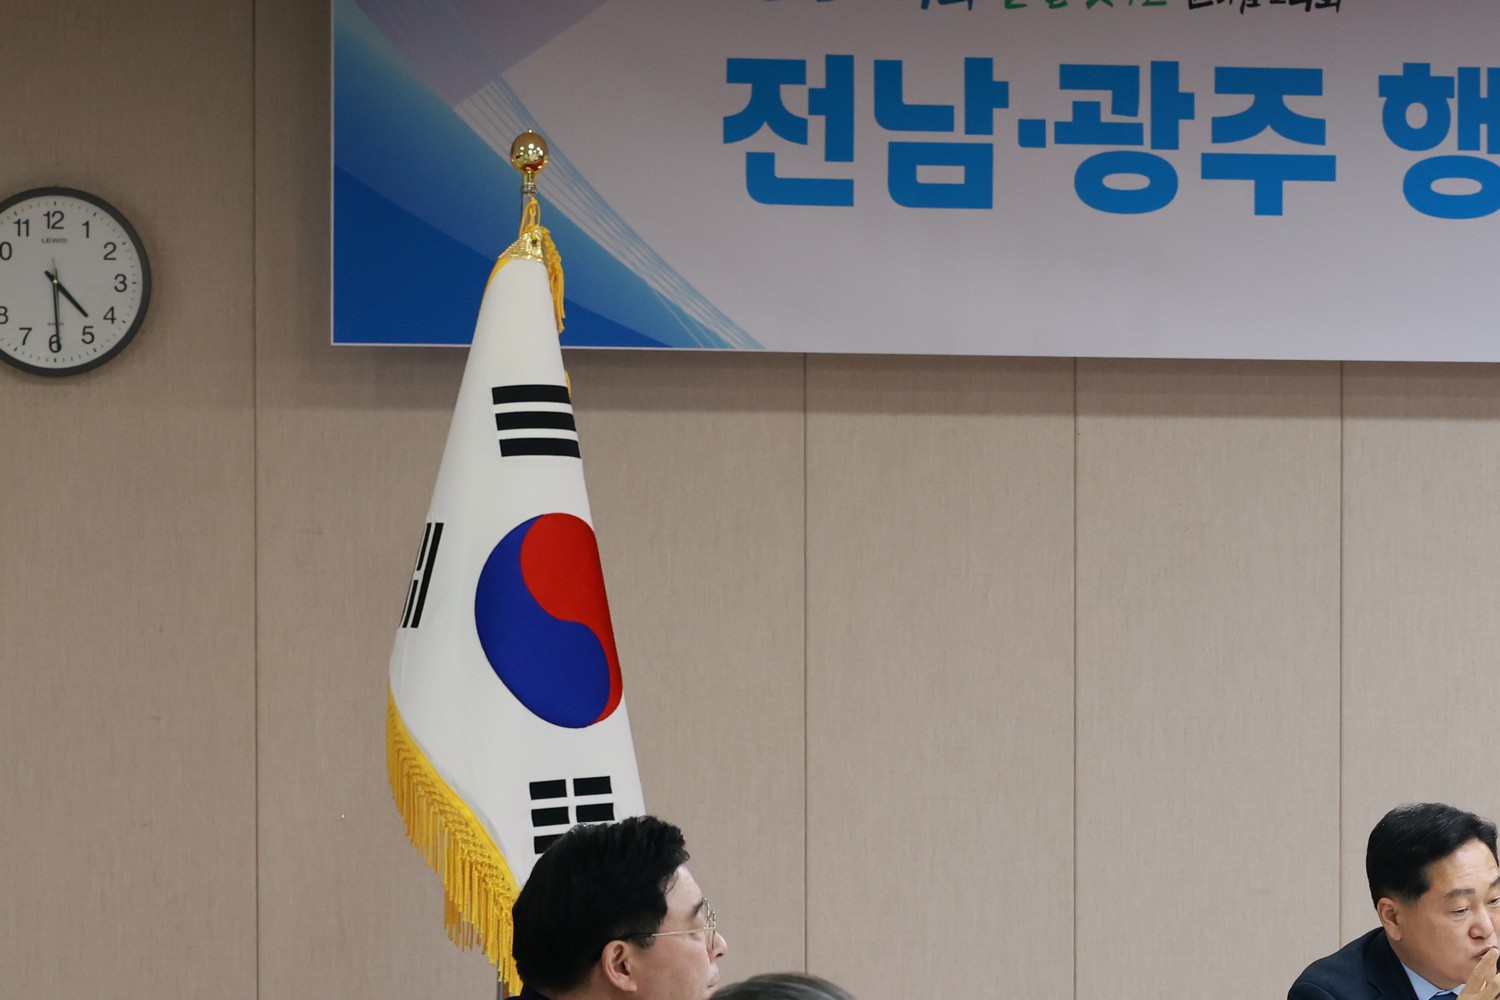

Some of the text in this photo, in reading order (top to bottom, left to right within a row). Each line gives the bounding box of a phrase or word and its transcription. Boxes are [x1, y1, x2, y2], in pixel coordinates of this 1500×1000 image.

[722, 54, 1337, 217] 전남·광주
[13, 218, 30, 237] 11
[43, 210, 64, 229] 12
[82, 220, 90, 239] 1
[103, 242, 117, 260] 2
[114, 274, 127, 292] 3
[103, 306, 116, 324] 4
[19, 327, 32, 345] 7
[81, 326, 95, 344] 5
